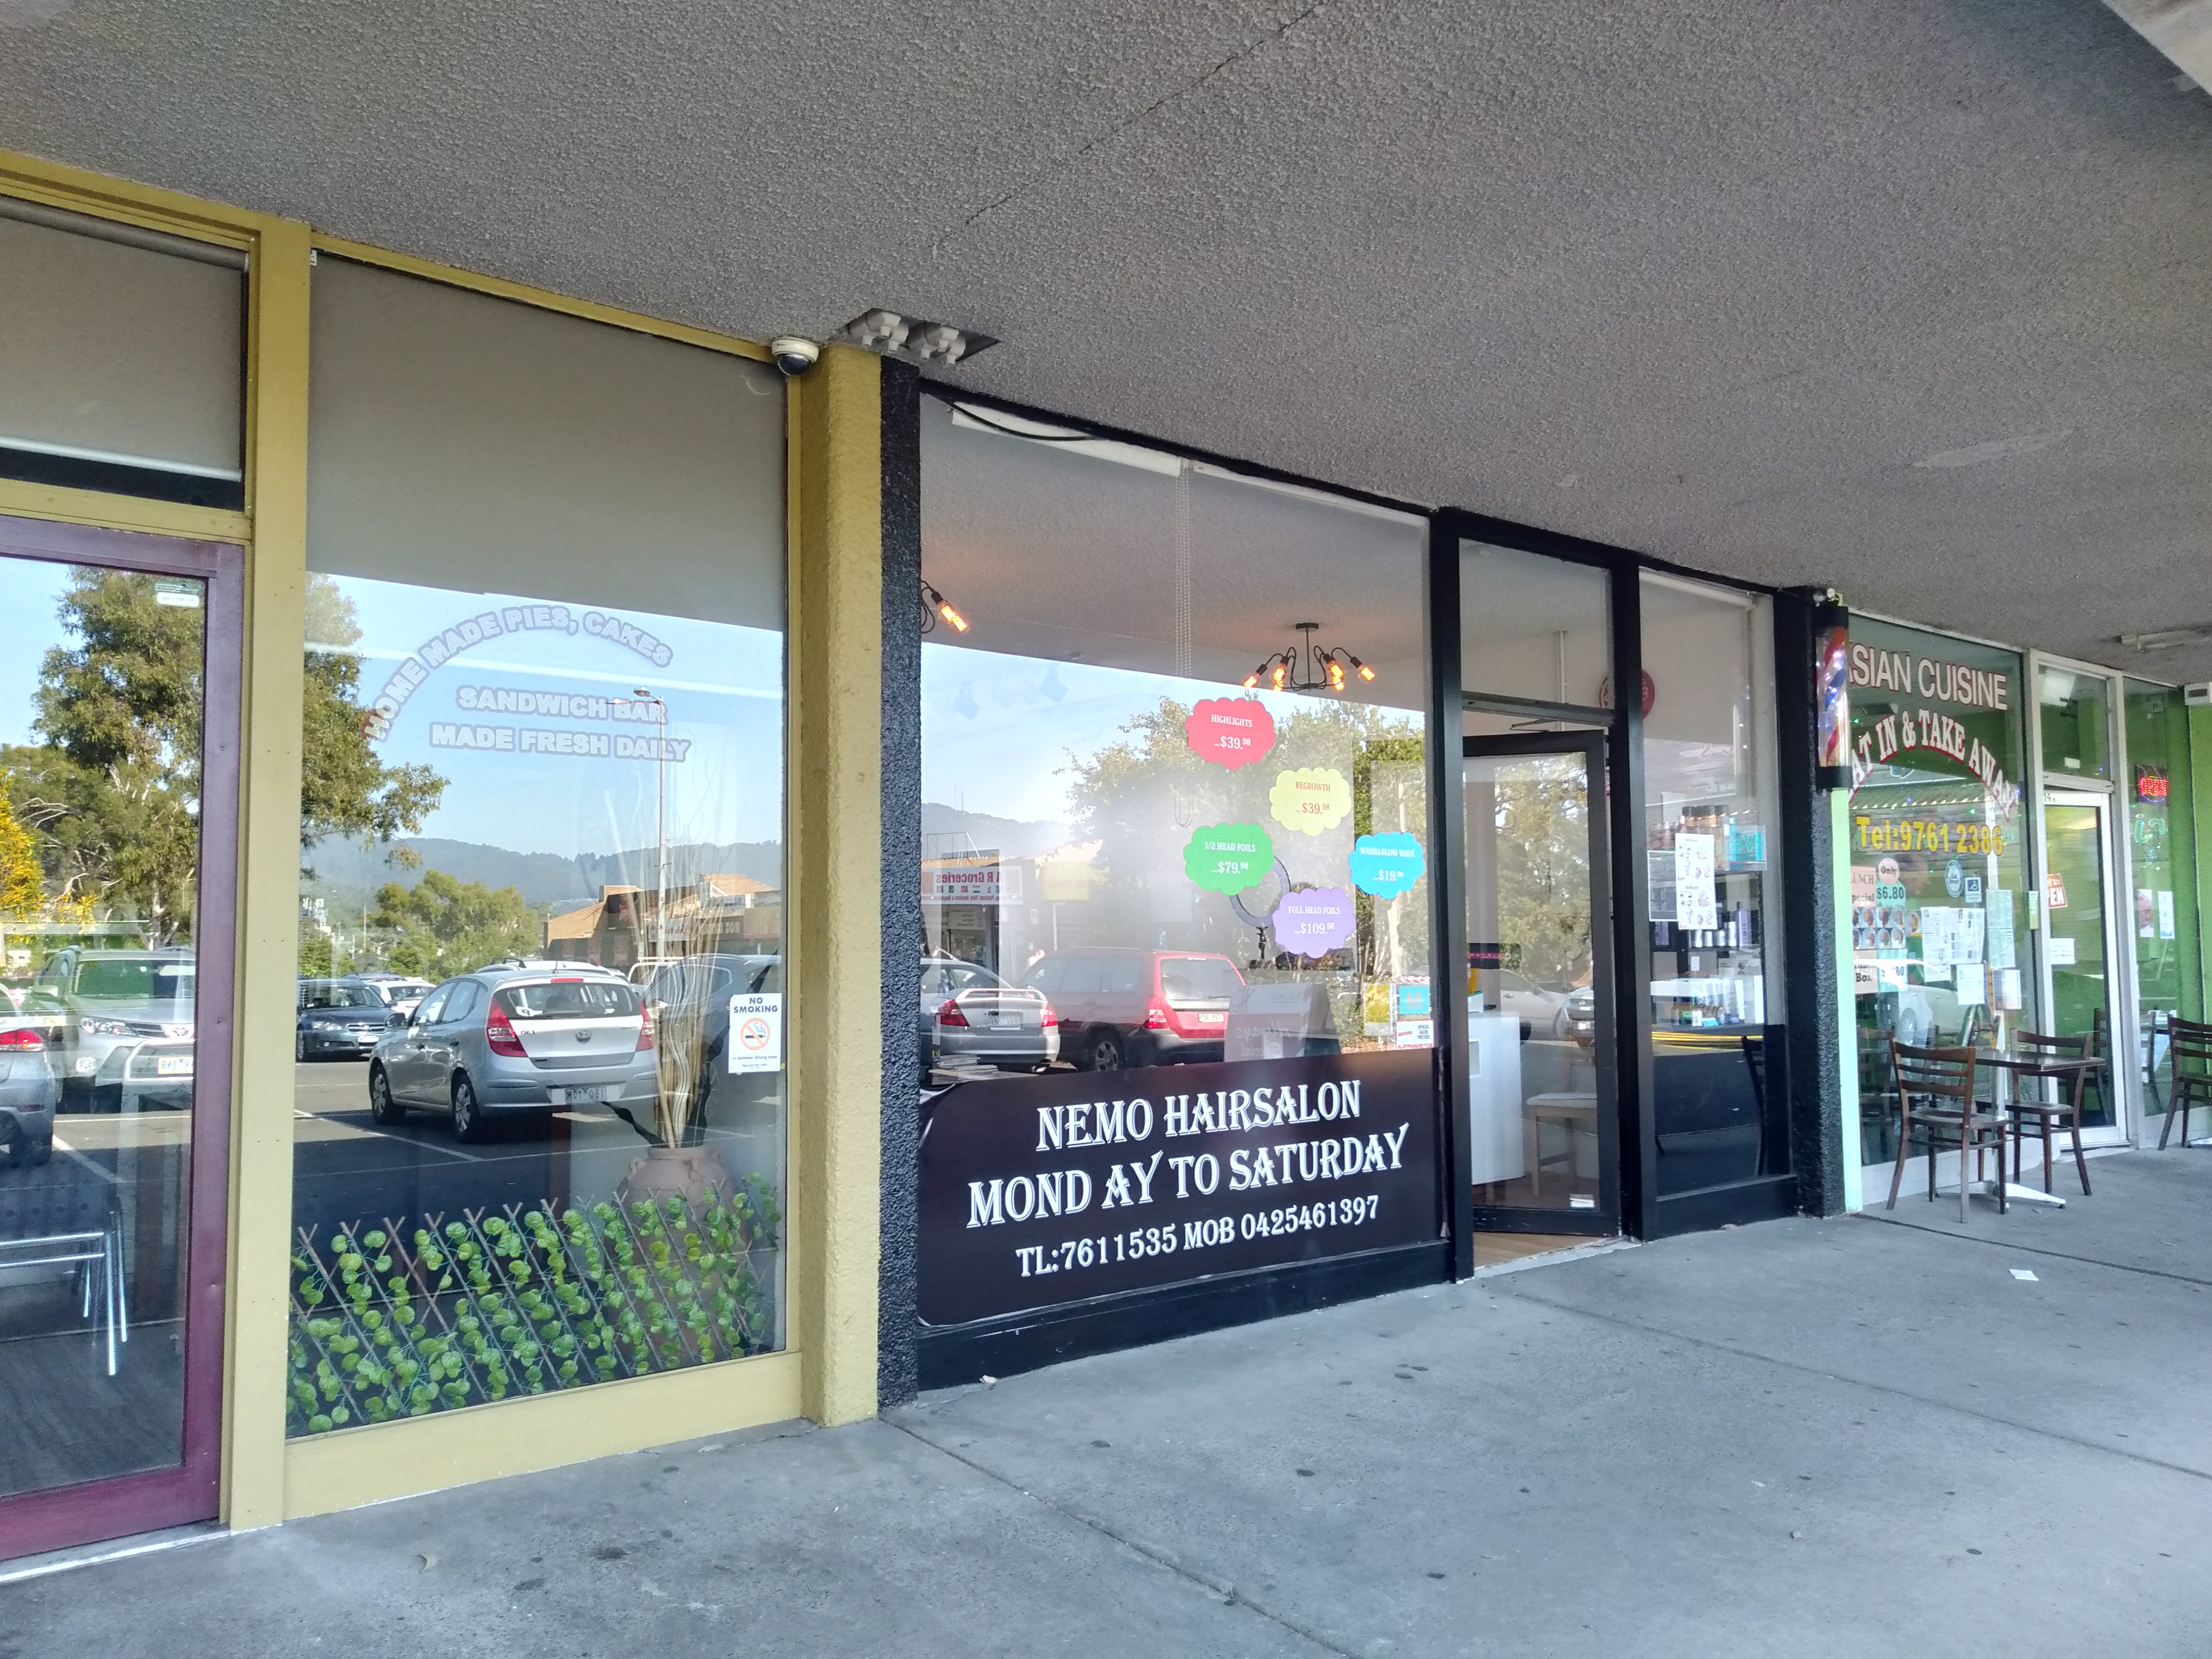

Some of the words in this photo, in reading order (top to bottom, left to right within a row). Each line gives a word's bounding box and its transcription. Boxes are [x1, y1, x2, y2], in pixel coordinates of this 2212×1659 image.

[364, 657, 427, 742] HOME
[420, 612, 501, 669] MADE
[503, 605, 577, 635] PIES,
[583, 611, 673, 667] CAKES
[1848, 643, 1911, 694] SIAN
[1918, 657, 2008, 710] CUISINE
[457, 685, 607, 719] SANDWICH
[613, 698, 668, 725] BAR
[1211, 714, 1252, 727] HIGHLIGHTS
[431, 723, 514, 751] MADE
[521, 730, 609, 758] FRESH
[616, 735, 691, 763] DAILY
[1849, 731, 1874, 795] AT
[1874, 715, 1898, 764] IN
[1902, 710, 1916, 751] &
[1918, 708, 1965, 764] TAKE
[1295, 781, 1330, 792] REGROWTH
[1204, 841, 1216, 850] 1/2
[1217, 842, 1236, 851] HEAD
[1237, 843, 1256, 852] FOILS
[1956, 824, 2004, 855] 2386
[1881, 866, 1897, 876] Only
[1851, 893, 1875, 904] pecial
[1876, 886, 1905, 900] $6.80
[1856, 973, 1872, 982] Box
[1036, 1098, 1154, 1152] NEMO
[1163, 1079, 1362, 1138] HAIRSALON
[965, 1170, 1092, 1229] MOND
[1101, 1150, 1163, 1209] AY
[1169, 1154, 1219, 1199] TO
[1229, 1122, 1410, 1191] SATURDAY
[1016, 1228, 1177, 1277] TL:7611535
[1183, 1216, 1234, 1250] MOB
[1241, 1195, 1380, 1241] 0425461397
